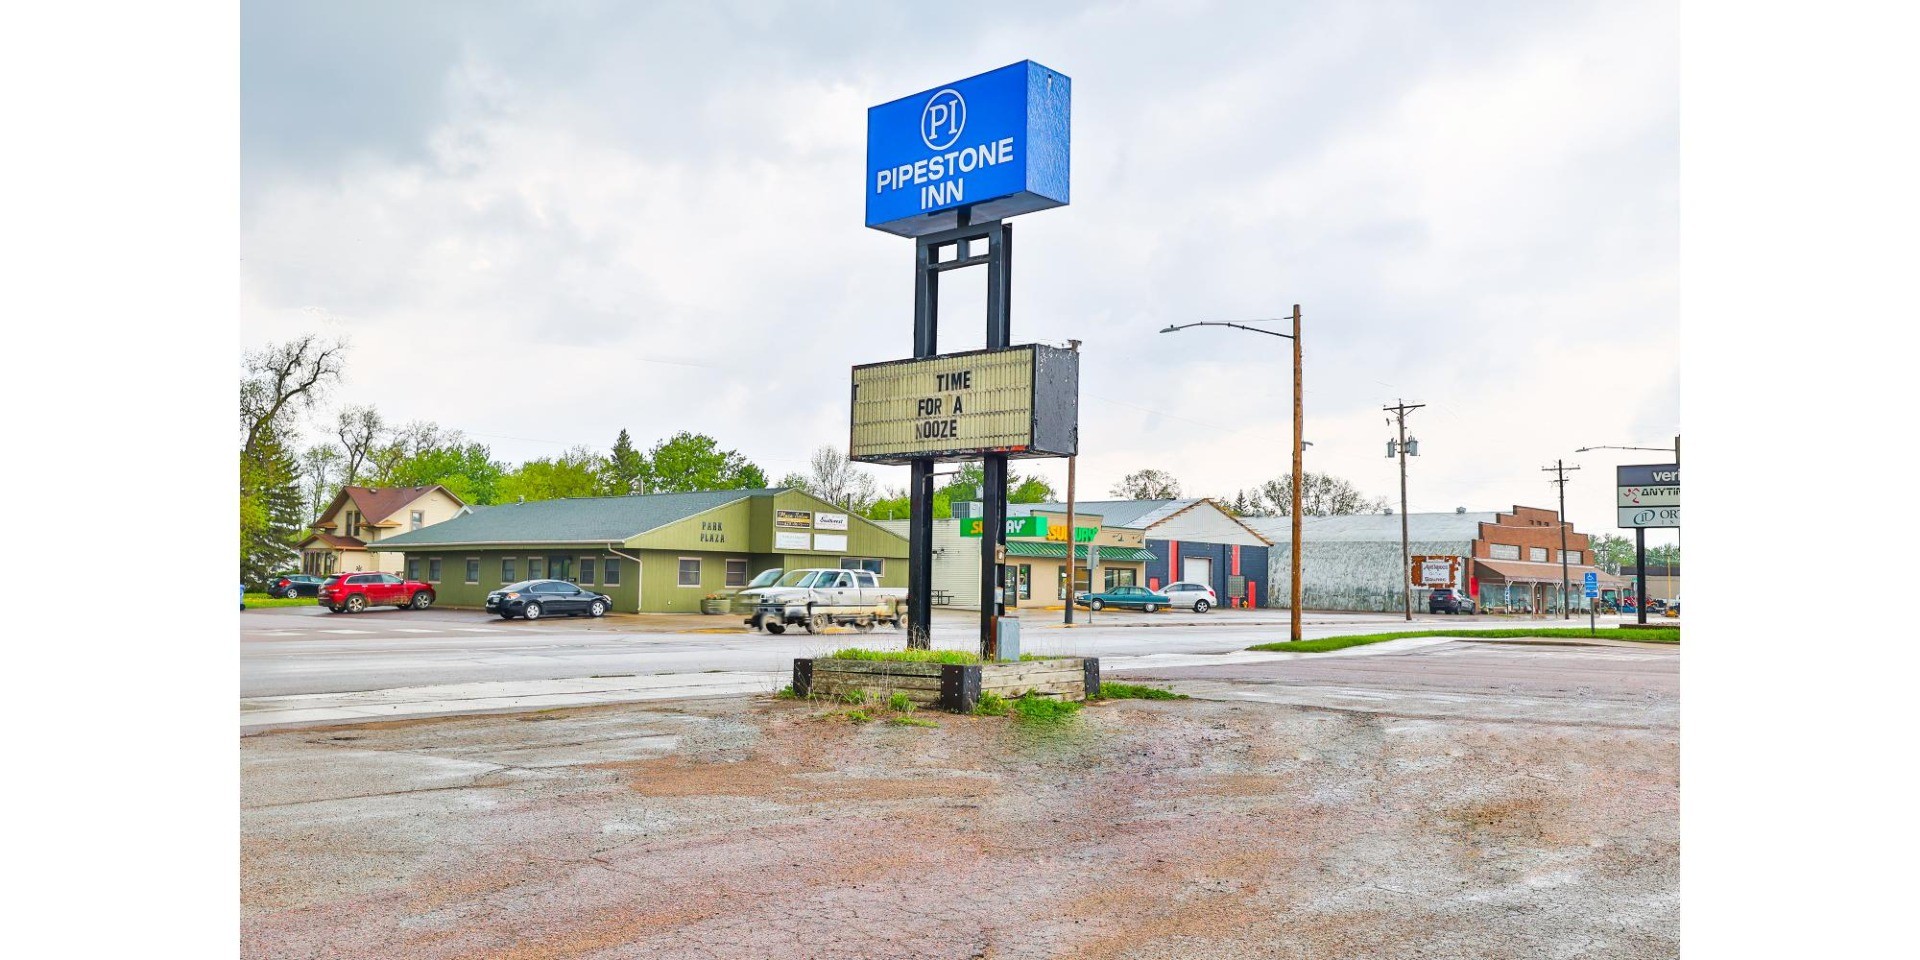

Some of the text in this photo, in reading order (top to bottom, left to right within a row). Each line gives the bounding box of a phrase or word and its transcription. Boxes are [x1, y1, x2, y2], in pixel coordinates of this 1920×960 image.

[928, 99, 958, 140] PI
[876, 137, 1014, 194] PIPESTONE
[921, 178, 964, 210] INN
[936, 370, 971, 392] TIME
[917, 395, 963, 417] FOR A
[915, 419, 957, 440] NOOZE
[701, 521, 723, 531] PARK
[1046, 525, 1099, 543] SUWAY
[700, 532, 725, 543] PLAZA
